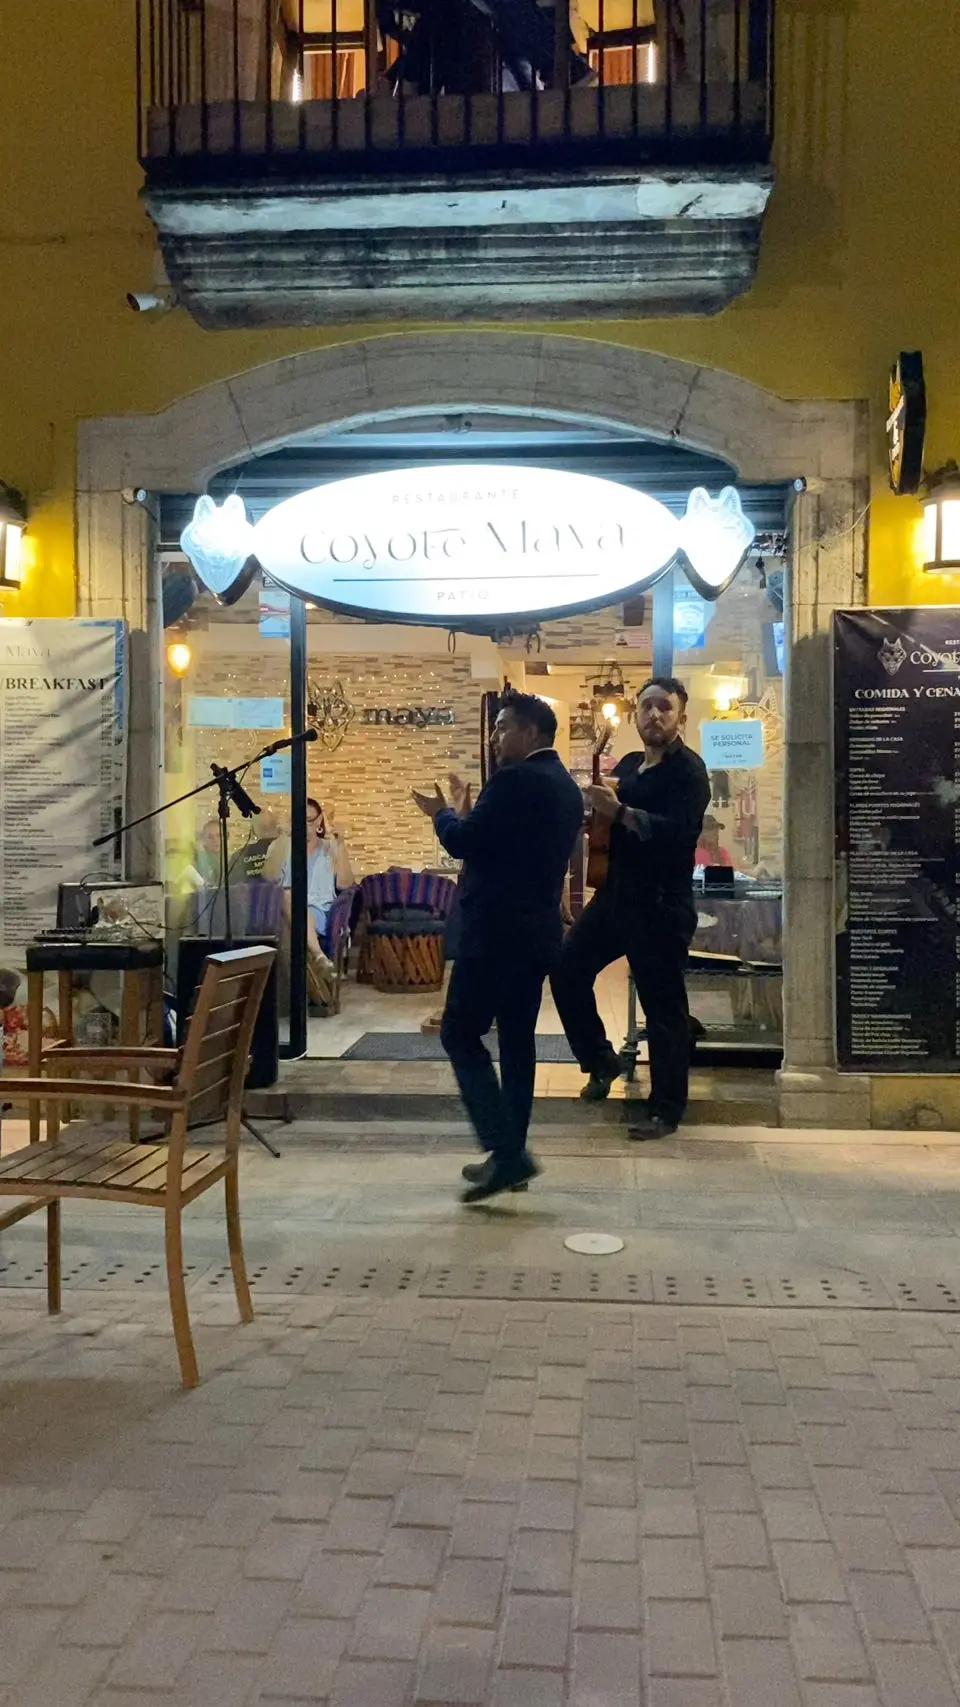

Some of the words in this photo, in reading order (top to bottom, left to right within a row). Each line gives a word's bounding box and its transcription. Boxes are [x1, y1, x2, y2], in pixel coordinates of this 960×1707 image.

[392, 488, 521, 505] RESTAURANTE
[436, 588, 490, 601] PATIO
[854, 687, 910, 699] COMIDA
[913, 685, 924, 698] Y
